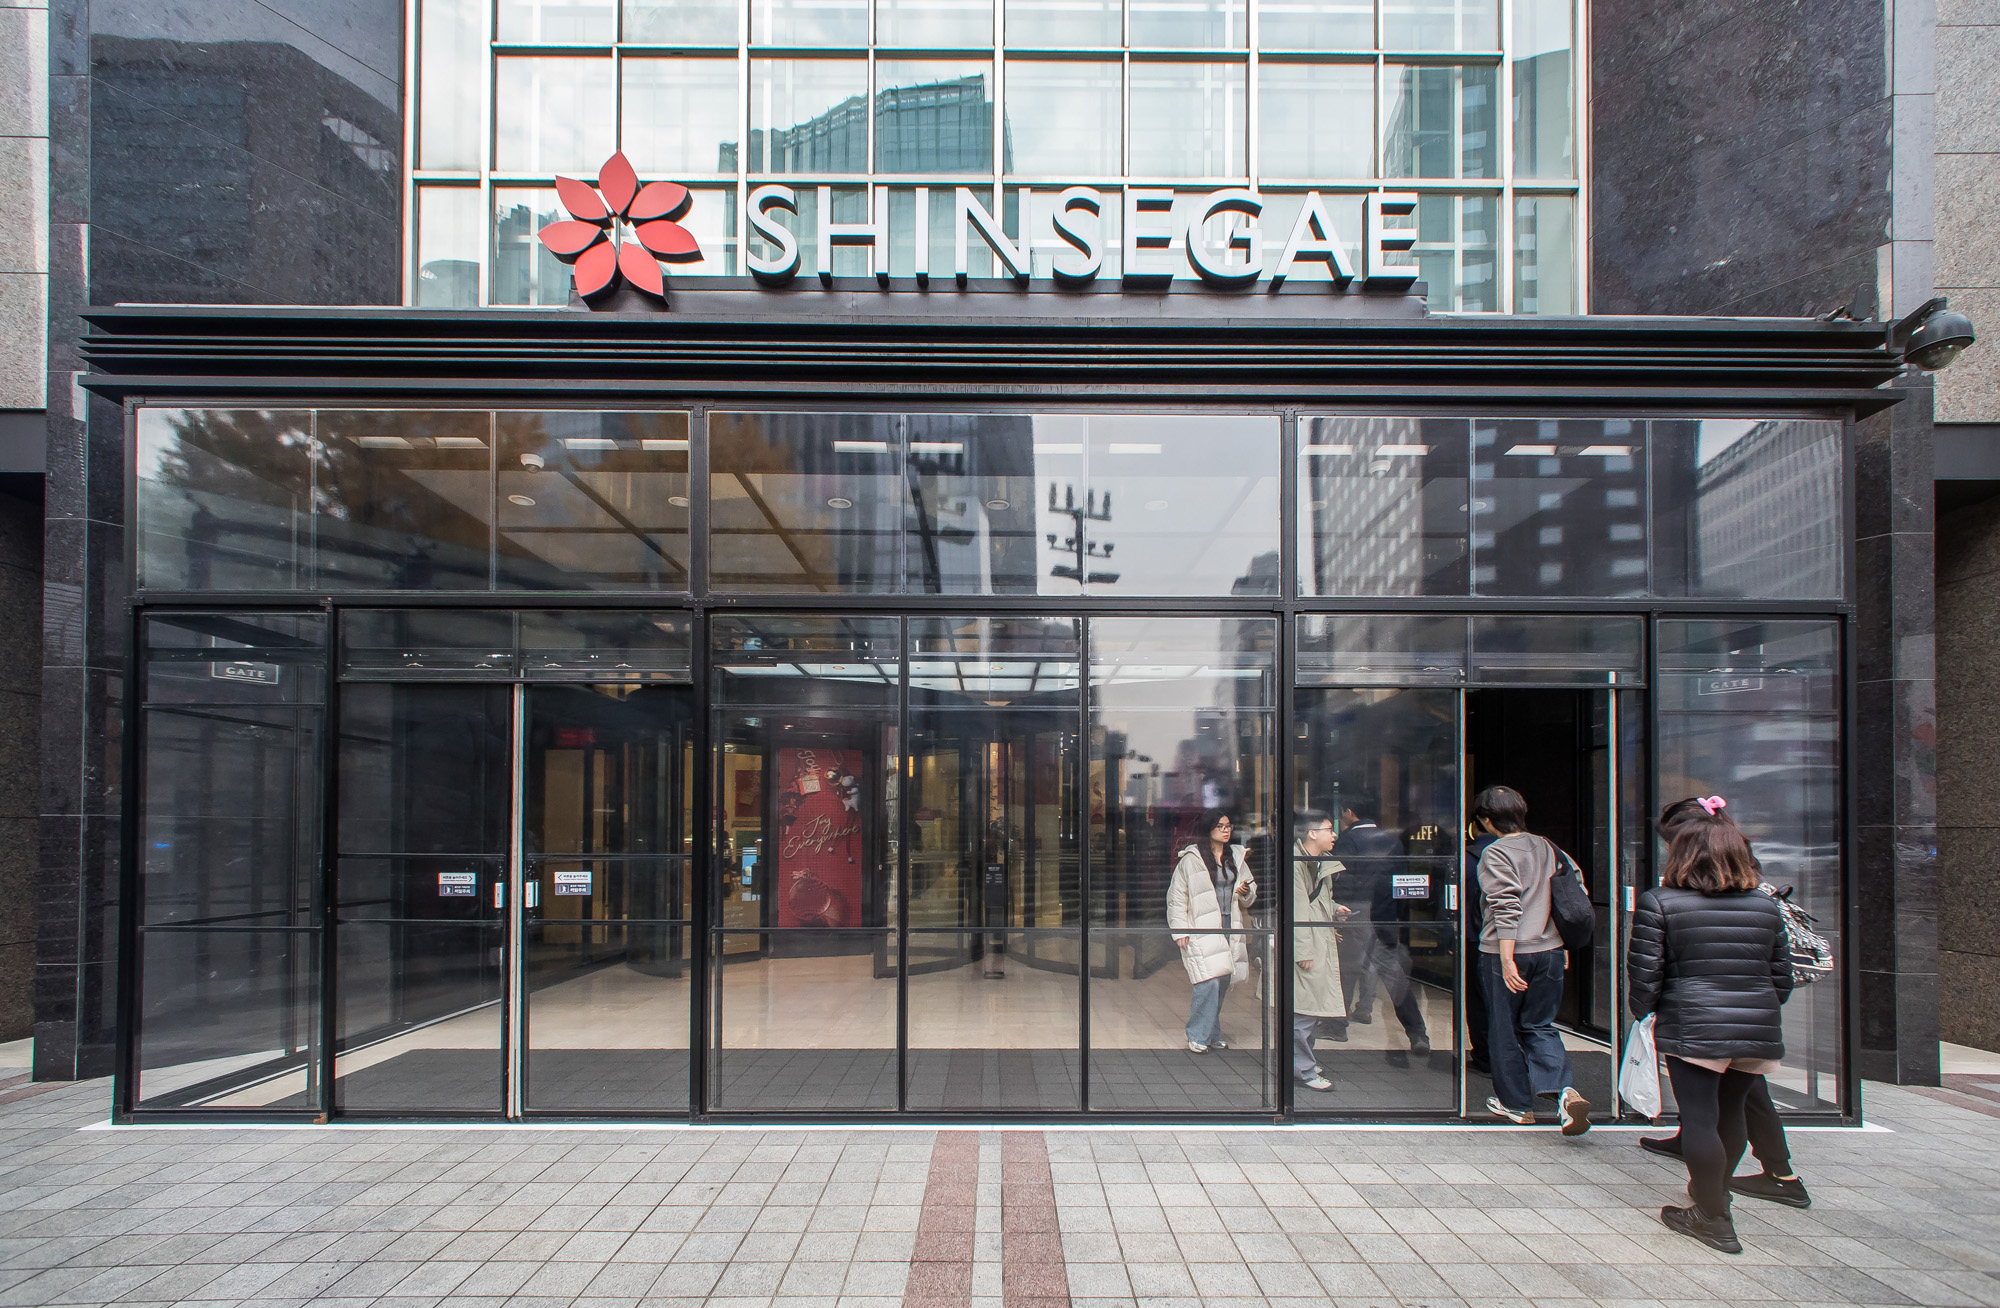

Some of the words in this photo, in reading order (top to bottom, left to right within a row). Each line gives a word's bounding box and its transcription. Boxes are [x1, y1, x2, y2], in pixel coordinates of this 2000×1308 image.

[747, 184, 1420, 287] SHINSEGAE
[225, 666, 267, 678] GATE
[1710, 678, 1750, 689] GATE
[802, 813, 832, 838] Joy
[783, 825, 859, 859] Everywhere
